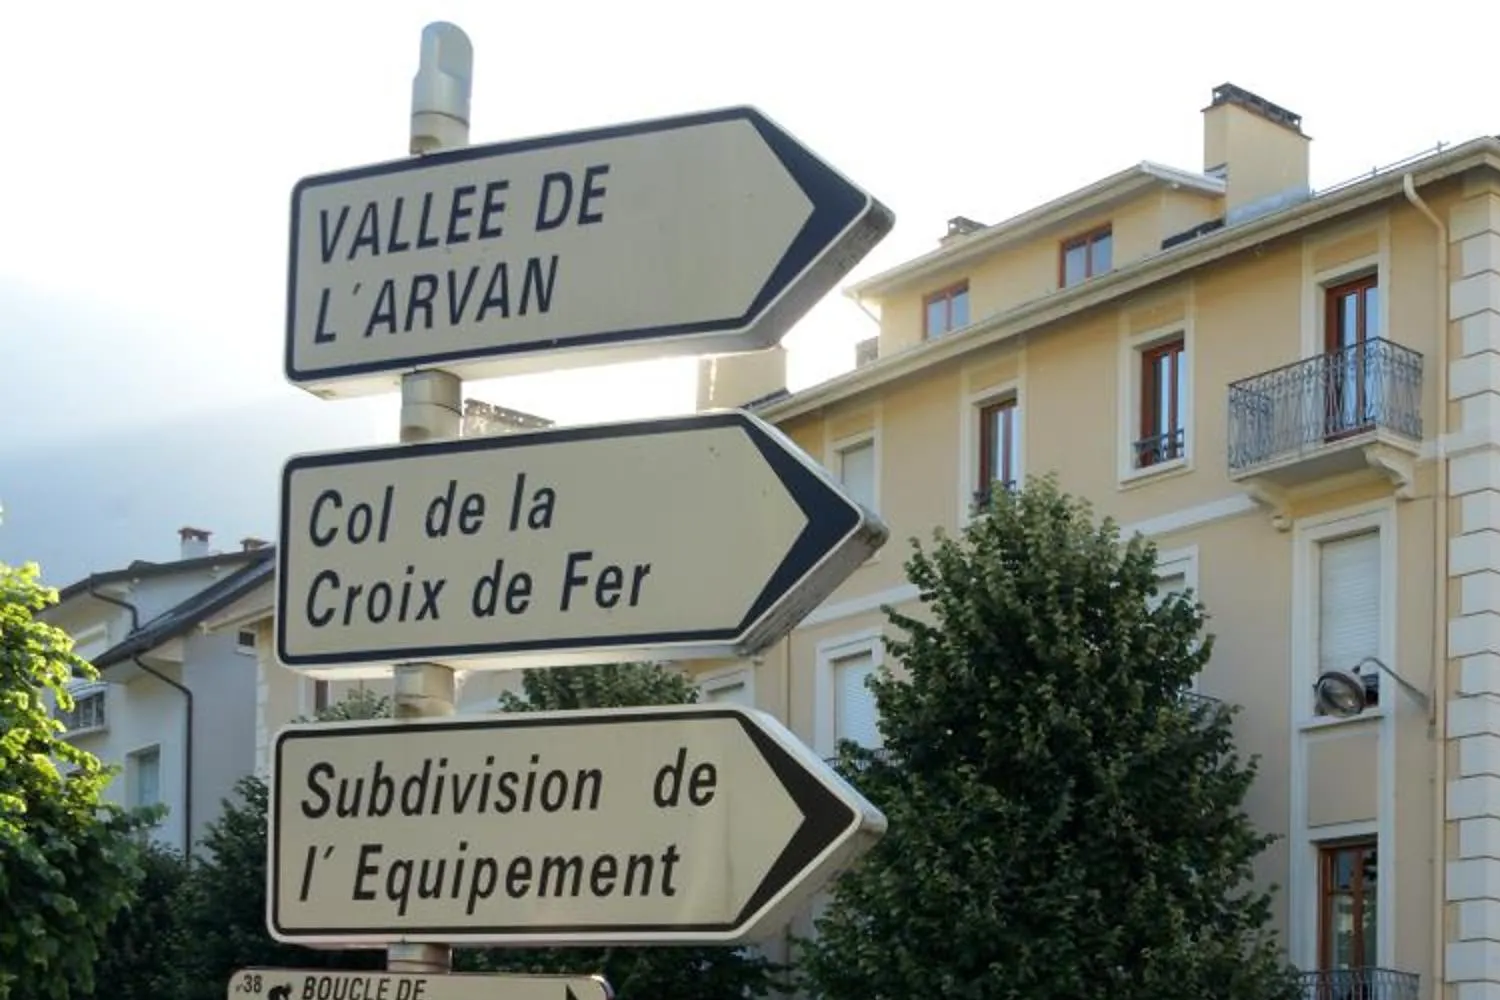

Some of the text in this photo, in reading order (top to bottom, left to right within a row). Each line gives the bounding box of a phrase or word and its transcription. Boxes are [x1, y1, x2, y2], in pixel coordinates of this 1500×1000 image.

[319, 164, 610, 265] VALLEE DE
[312, 255, 559, 345] L'ARVAN
[309, 472, 556, 548] Col de la
[306, 551, 651, 628] Croix de Fer
[300, 747, 717, 820] Subdivision de
